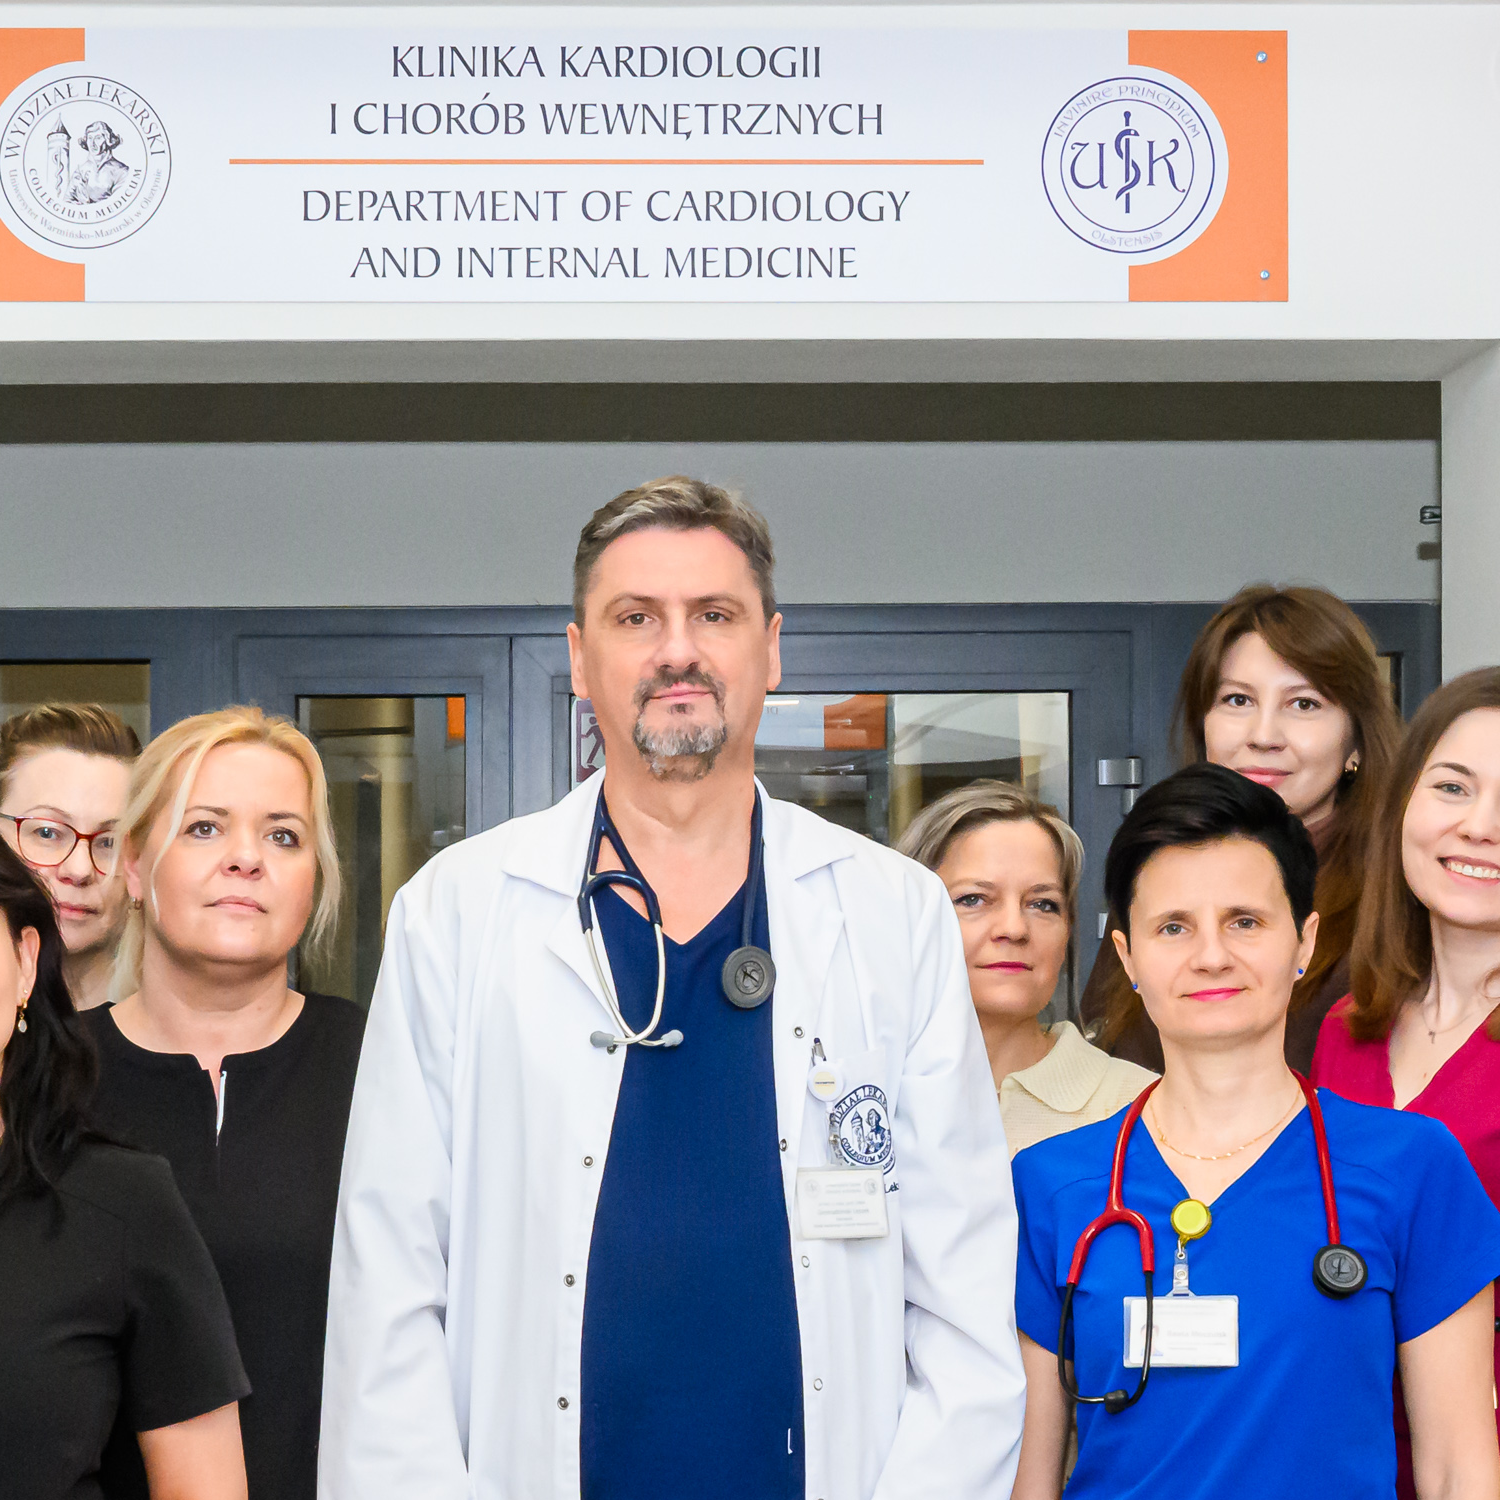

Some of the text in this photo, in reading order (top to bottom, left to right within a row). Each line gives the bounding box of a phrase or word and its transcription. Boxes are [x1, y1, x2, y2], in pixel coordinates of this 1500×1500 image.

[392, 45, 821, 78] KLINIKA KARDIOLOGII
[4, 81, 166, 159] WYDZIAŁ LEKARSKI
[330, 92, 883, 141] I CHORÓB WEWNĘTRZNYCH
[8, 168, 39, 220] Uniwersytet
[141, 168, 163, 209] Olsztynie
[29, 168, 142, 220] COLLEGIUM MEDICUM
[303, 190, 910, 222] DEPARTMENT OF CARDIOLOGY
[350, 246, 858, 278] AND INTERNAL MEDICINE
